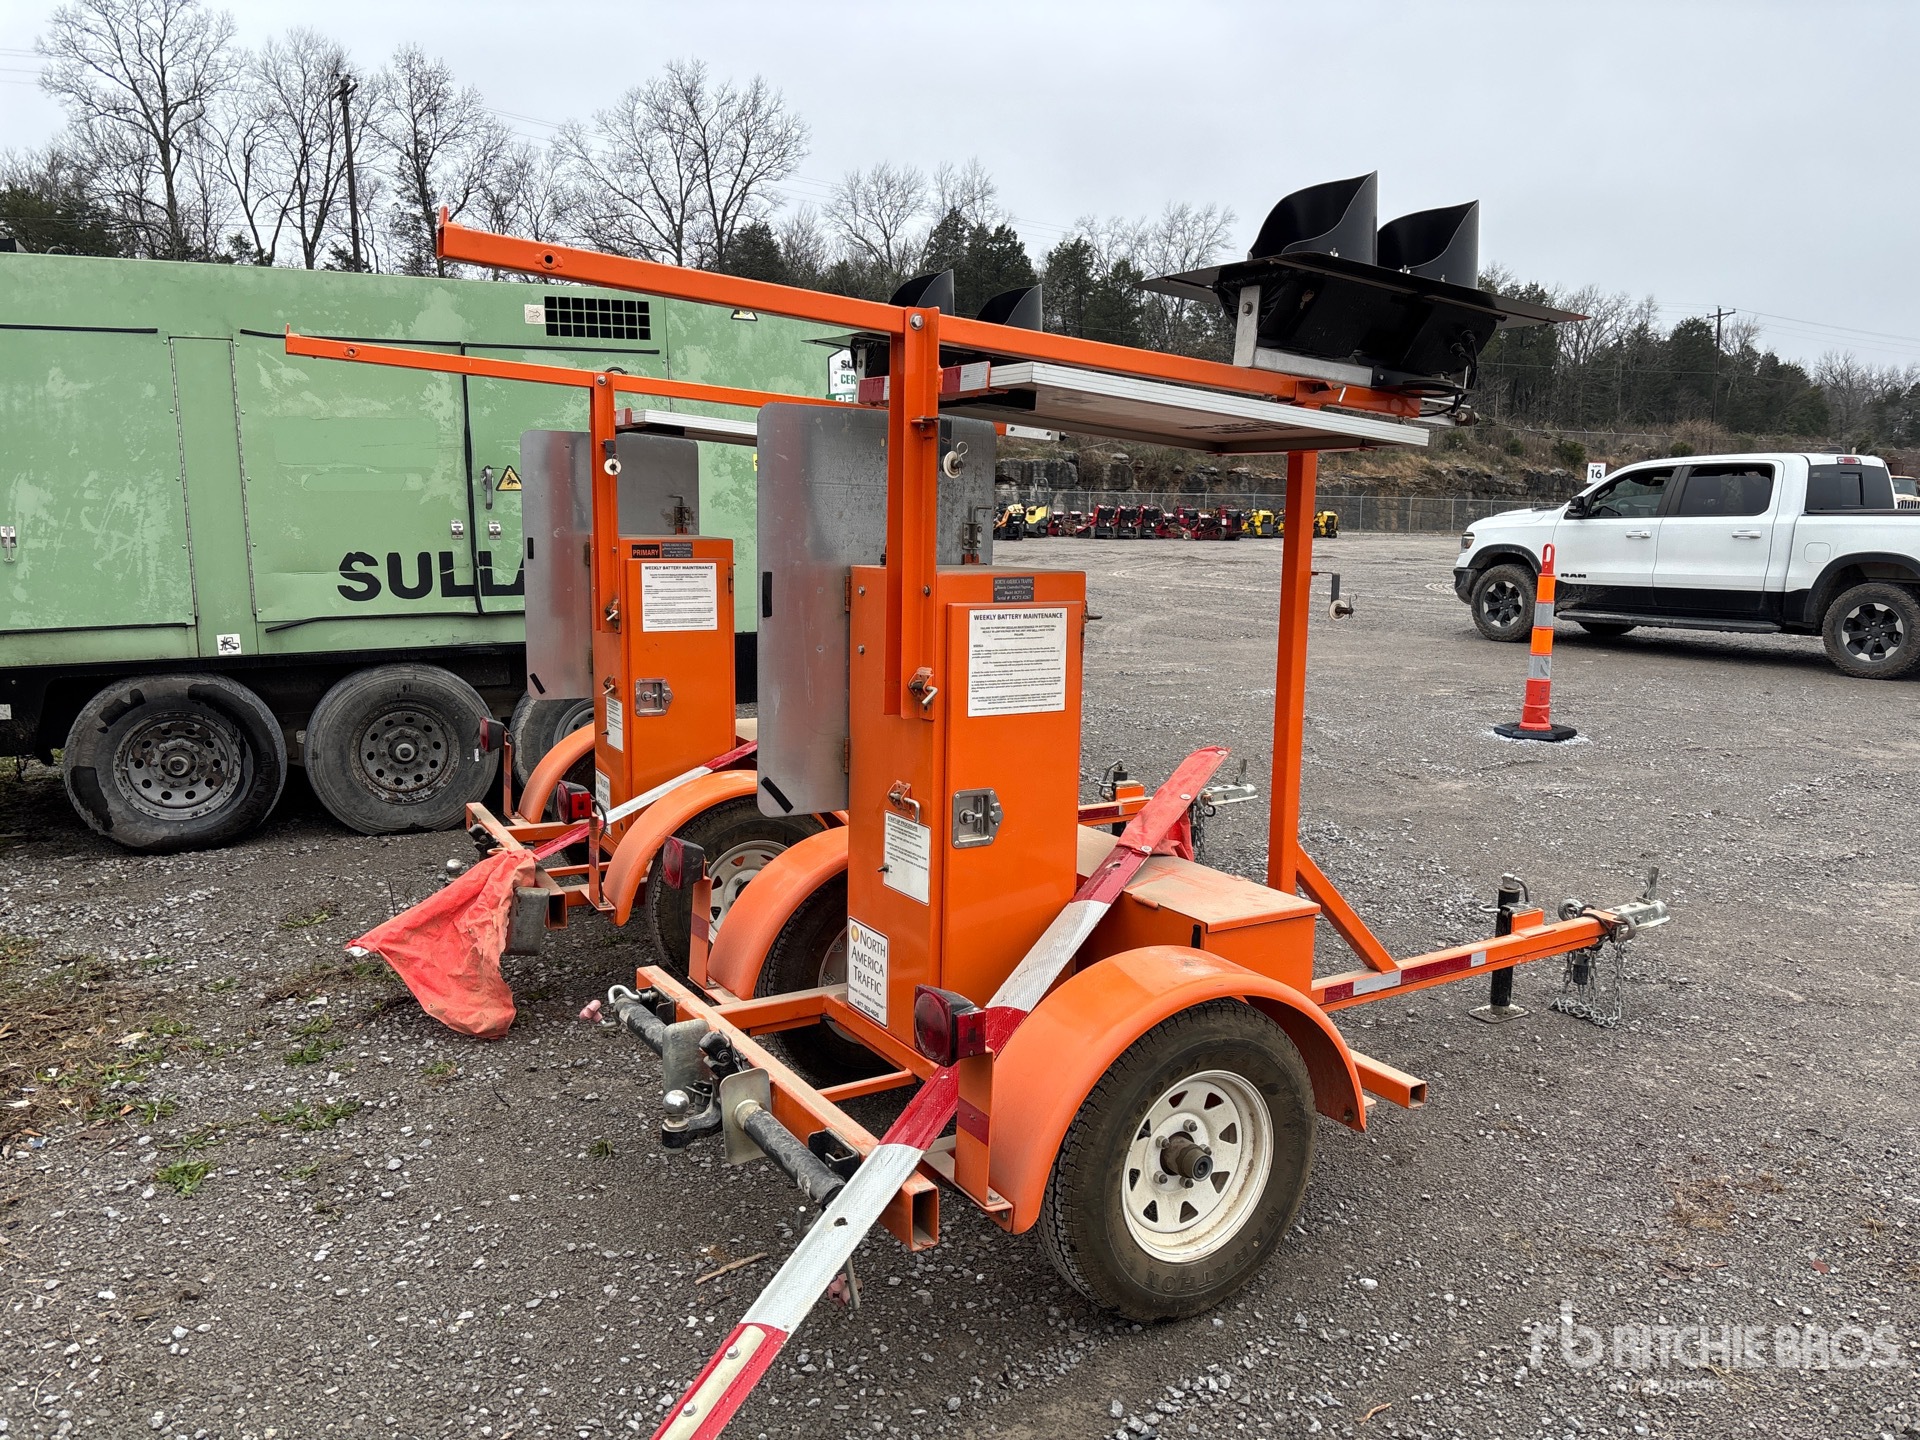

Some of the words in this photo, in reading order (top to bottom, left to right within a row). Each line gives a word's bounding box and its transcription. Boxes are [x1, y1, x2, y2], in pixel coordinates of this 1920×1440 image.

[1590, 469, 1602, 478] 16
[860, 930, 886, 958] NORTH
[851, 946, 884, 977] AMERICA
[853, 965, 881, 995] TRAFFIC
[1144, 1204, 1280, 1292] MARATHON
